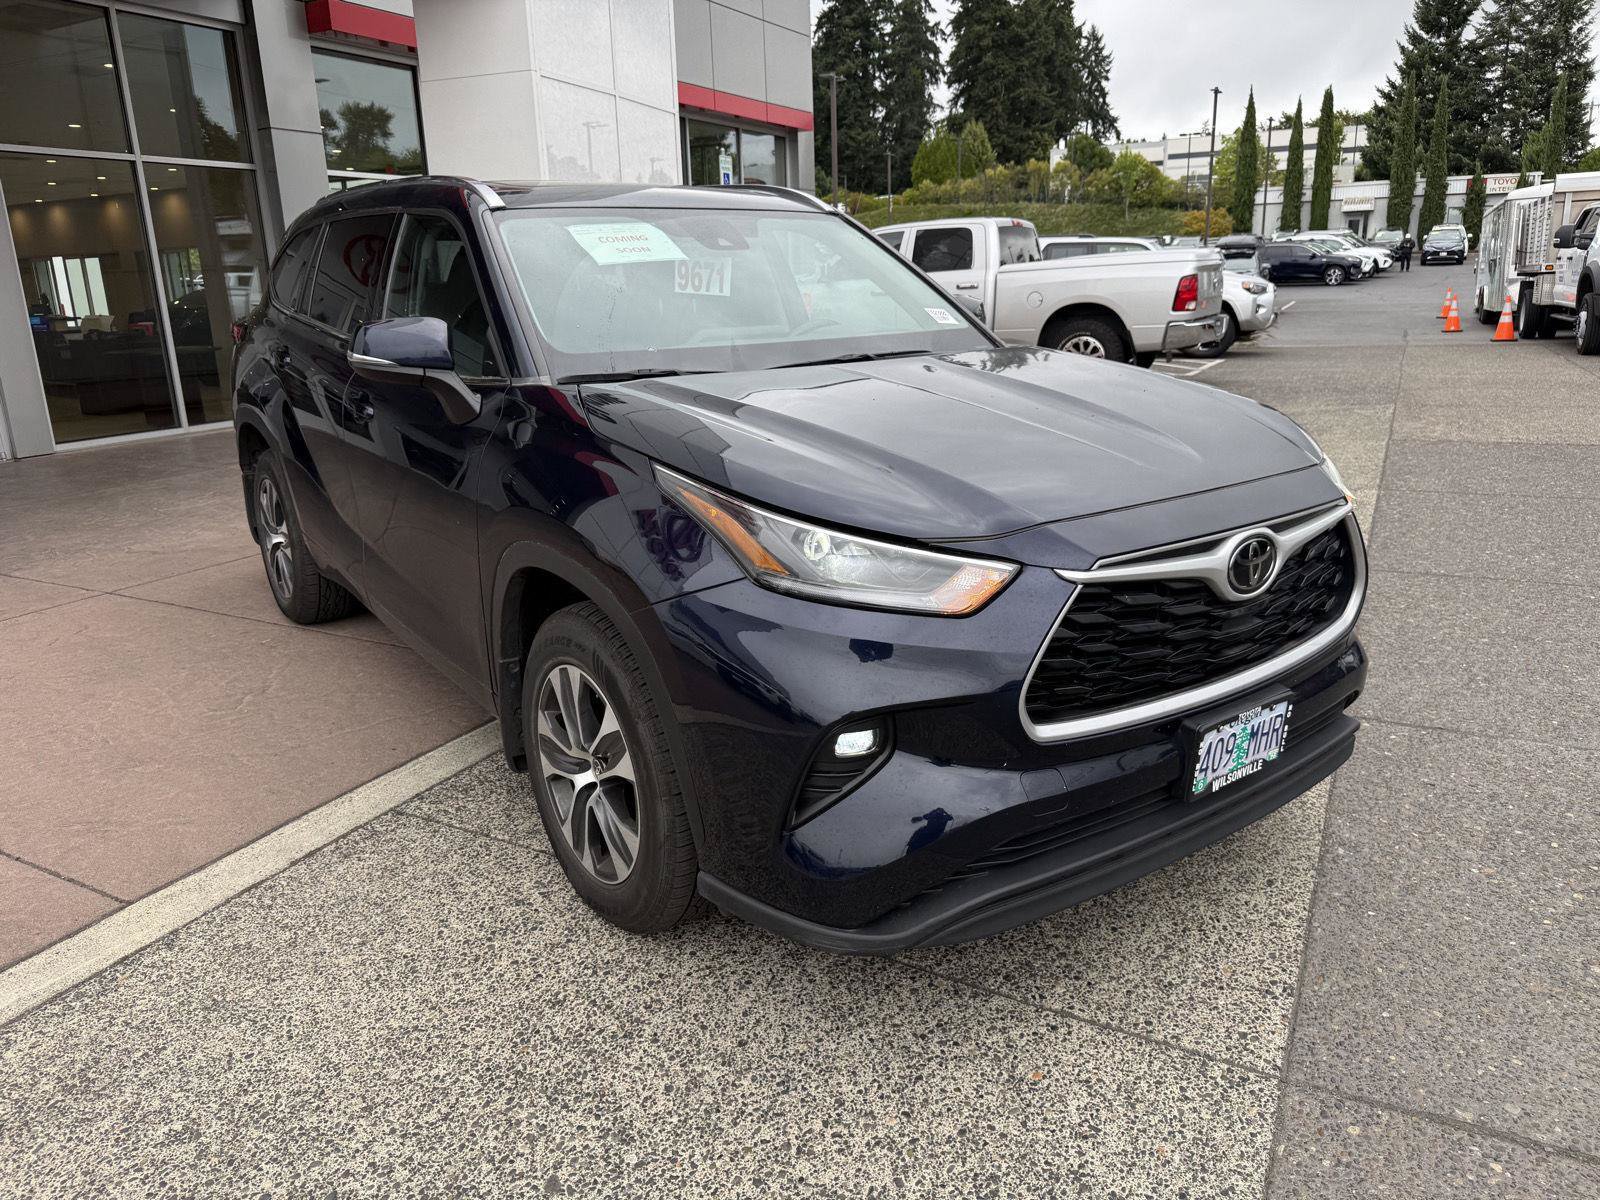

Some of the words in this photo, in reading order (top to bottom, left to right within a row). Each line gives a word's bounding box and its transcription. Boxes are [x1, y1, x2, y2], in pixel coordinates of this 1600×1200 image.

[1492, 177, 1519, 186] TOYO
[598, 234, 648, 244] COMING
[616, 246, 652, 254] SOON
[677, 261, 725, 293] 9671
[1199, 732, 1237, 778] 409
[1245, 713, 1284, 759] MHR
[1212, 759, 1264, 792] WILSONVILLE
